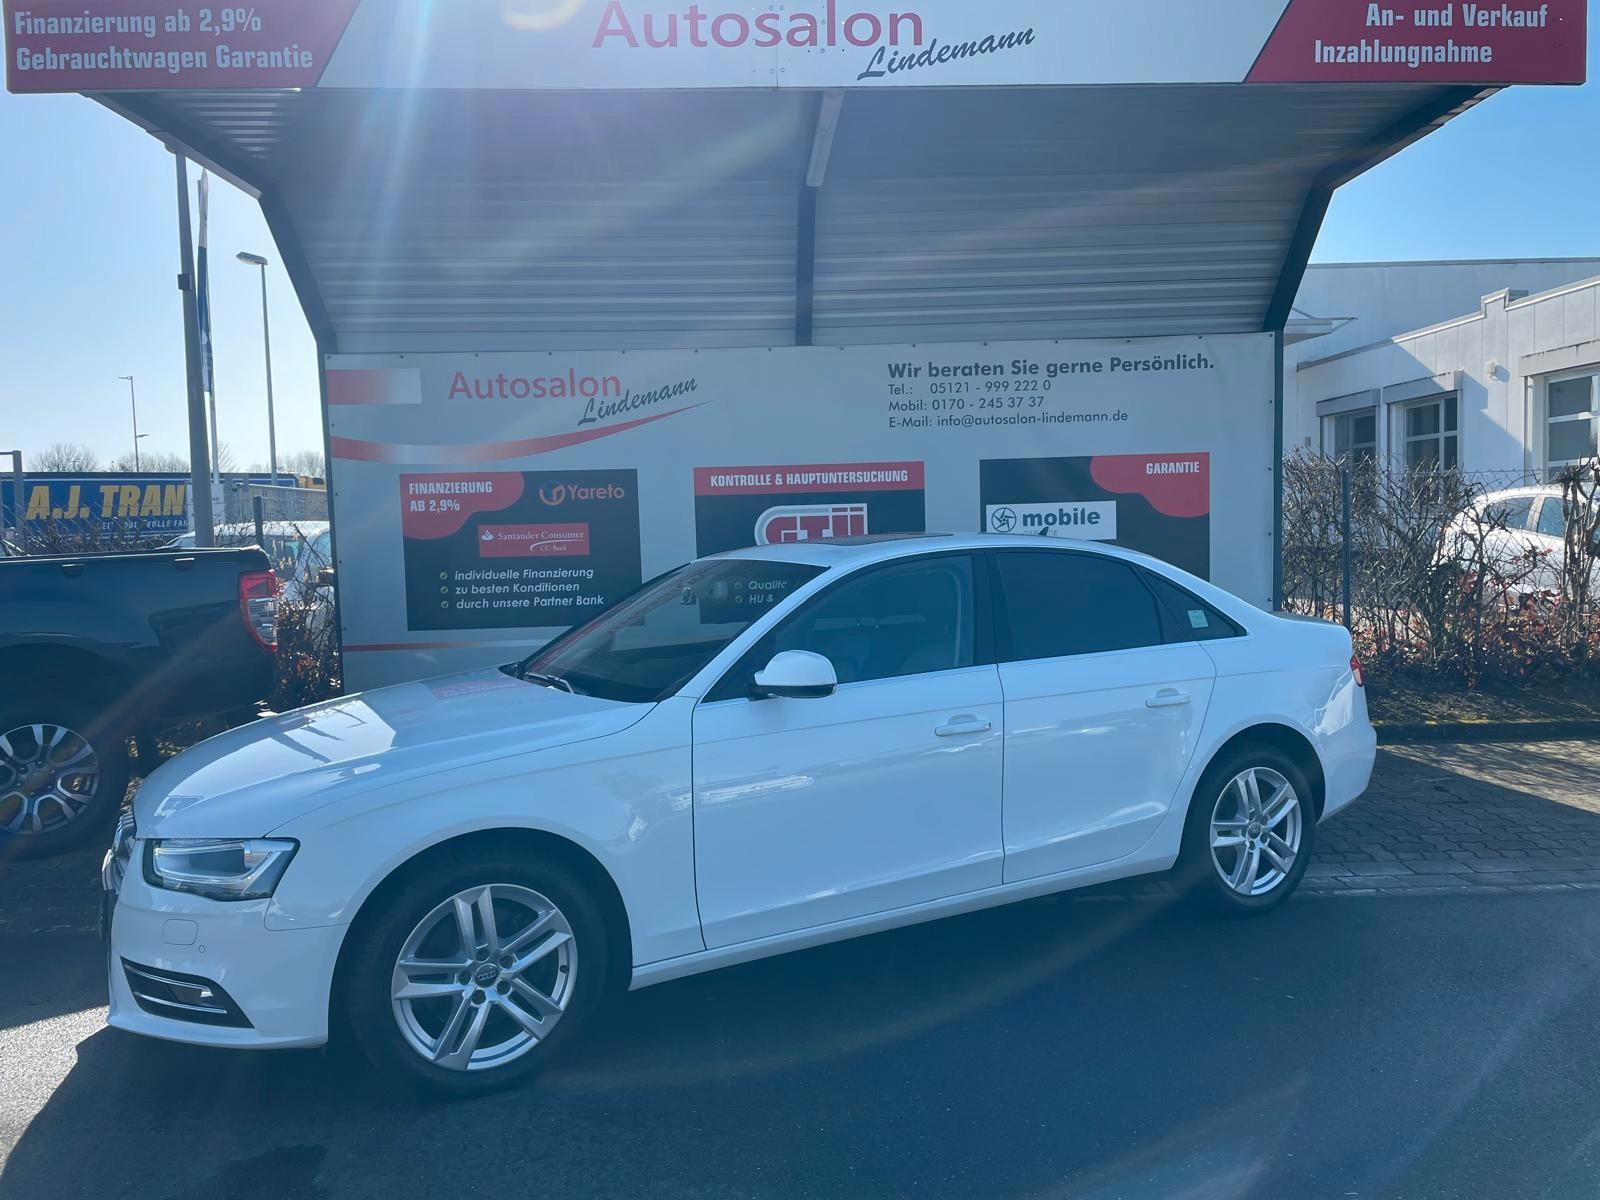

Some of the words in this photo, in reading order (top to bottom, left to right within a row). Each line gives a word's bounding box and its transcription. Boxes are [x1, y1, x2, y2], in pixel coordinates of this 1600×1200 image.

[15, 10, 156, 37] Finanzierung
[164, 9, 191, 33] ab
[199, 8, 262, 36] 2,9%
[1366, 3, 1404, 27] An-
[1414, 4, 1453, 27] und
[1463, 3, 1548, 28] Verkauf
[592, 0, 922, 48] Autosalon
[857, 26, 1036, 81] Lindemann
[16, 46, 208, 74] Gebrauchtwagen
[215, 44, 313, 69] Garantie
[1315, 39, 1493, 68] Inzahlungnahme
[888, 362, 922, 378] Wir
[928, 361, 1004, 377] beraten
[1011, 359, 1039, 375] Sie
[1046, 359, 1103, 378] gerne
[1110, 353, 1215, 372] Persönlich.
[888, 383, 913, 396] Tel.:
[930, 381, 970, 395] 05121
[985, 380, 1009, 394] 999
[1014, 379, 1038, 392] 222
[1042, 379, 1051, 391] 0
[448, 368, 621, 400] Autosalon
[577, 377, 698, 426] Lindemann
[888, 399, 927, 412] Mobil:
[932, 398, 965, 411] 0170
[978, 397, 1003, 410] 245
[1007, 397, 1024, 409] 37
[1028, 396, 1045, 408] 37
[889, 415, 933, 428] E-Mail:
[937, 410, 1128, 427] info@autosalon-lindemann.de
[1146, 461, 1200, 474] GARANTIE
[710, 473, 772, 487] KONTROLLE
[775, 474, 783, 486] &
[786, 470, 908, 485] HAUPTUNTERSUCHUNG
[408, 480, 493, 495] FINANZIERUNG
[567, 484, 625, 500] Yareto
[26, 485, 90, 520] A.J.
[410, 499, 426, 512] AB
[429, 498, 460, 513] 2,9%
[1023, 507, 1101, 527] mobile
[497, 531, 539, 540] Santander
[541, 530, 584, 540] Consumer
[454, 569, 520, 581] individuelle
[523, 568, 594, 580] Finanzierung
[455, 585, 469, 595] zu
[471, 583, 509, 594] besten
[513, 582, 580, 593] Konditionen
[456, 598, 489, 609] durch
[492, 599, 530, 608] unsere
[533, 596, 573, 607] Partner
[576, 595, 604, 606] Bank
[750, 594, 764, 604] HU
